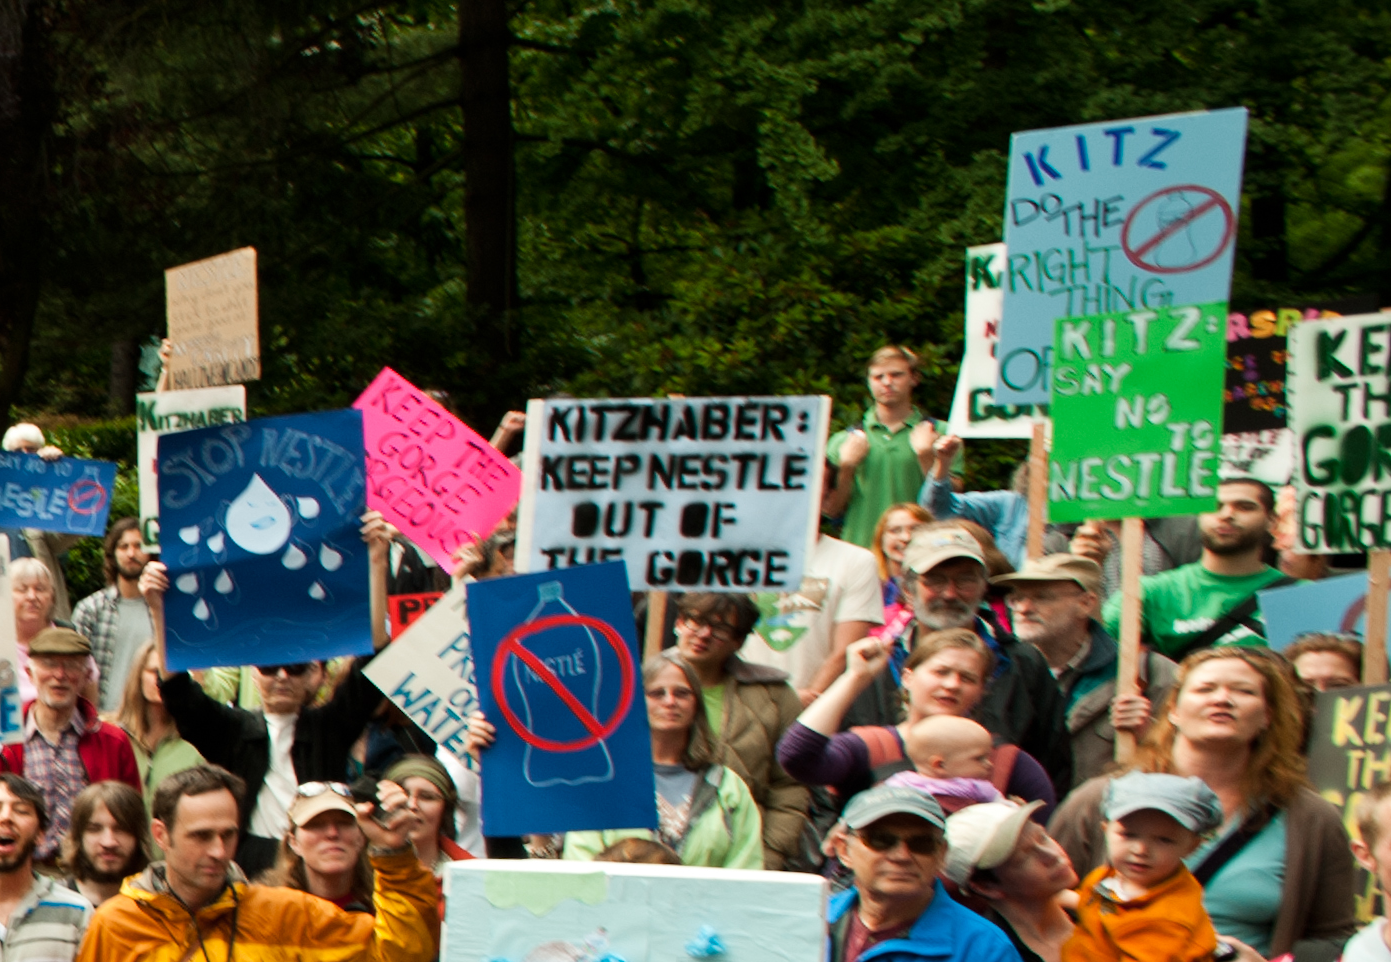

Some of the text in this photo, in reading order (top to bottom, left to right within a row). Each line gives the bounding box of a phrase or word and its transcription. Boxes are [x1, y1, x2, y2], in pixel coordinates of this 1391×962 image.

[1023, 126, 1182, 187] KITZ
[1061, 195, 1125, 237] THE
[1008, 241, 1121, 294] RIGHT
[1048, 276, 1174, 316] THING
[1316, 325, 1391, 382] KE
[1054, 363, 1132, 396] SAY
[1114, 393, 1172, 430] NO
[1332, 382, 1391, 421] TH
[371, 377, 510, 492] KEEP THE
[547, 402, 809, 443] KITZHABER:
[1165, 419, 1215, 452] TO
[24, 458, 47, 475] NO
[53, 461, 73, 477] TO
[160, 424, 365, 517] STOP NESTLE
[377, 431, 482, 514] GORGE
[540, 453, 641, 491] KEEP
[1048, 451, 1215, 502] NESTLE
[571, 501, 738, 539] OUT OF
[646, 550, 790, 588] GORGE
[1331, 690, 1391, 747] KE
[1347, 749, 1391, 790] TH
